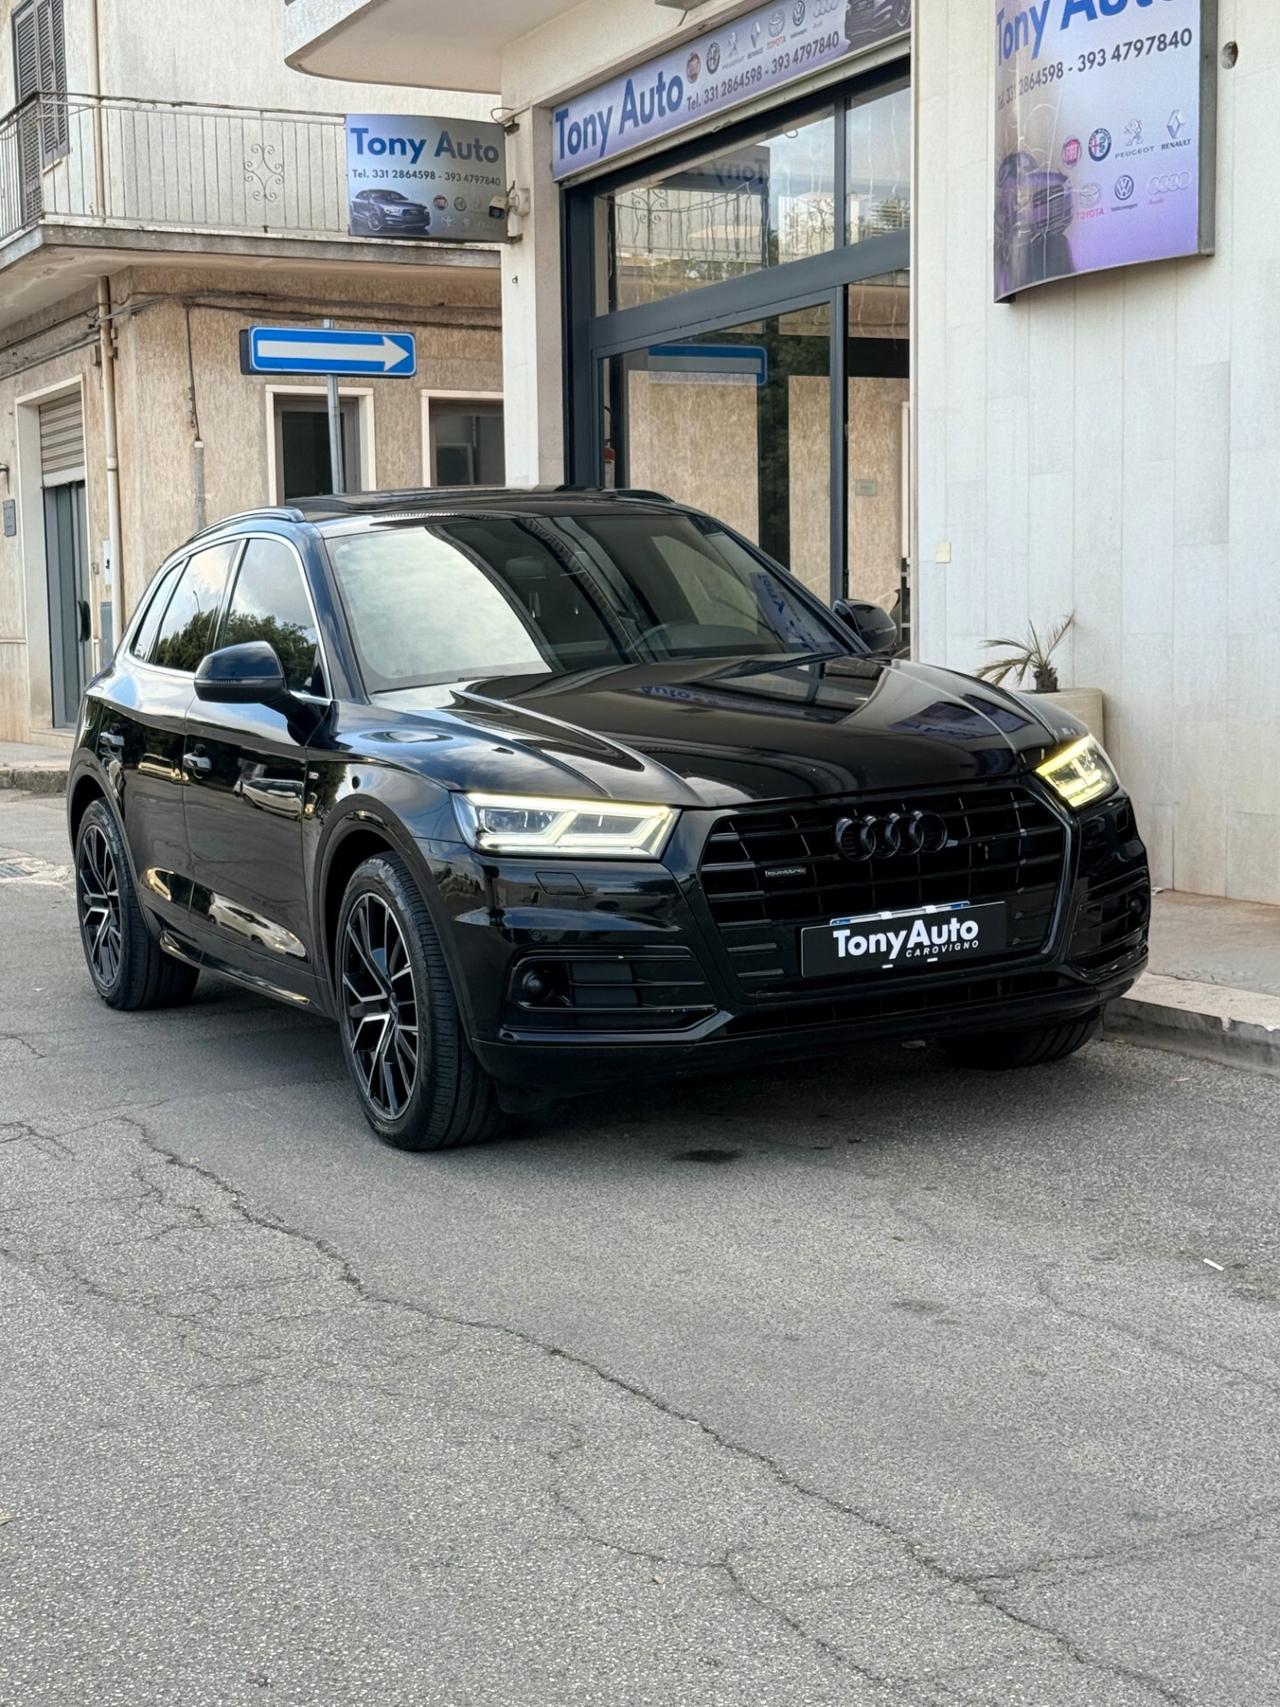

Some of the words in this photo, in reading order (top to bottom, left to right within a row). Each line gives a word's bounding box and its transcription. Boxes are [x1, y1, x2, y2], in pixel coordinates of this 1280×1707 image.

[996, 0, 1050, 66] Tony
[1060, 0, 1172, 30] Au
[687, 95, 701, 112] Tel.
[704, 87, 719, 104] 331
[721, 65, 762, 97] 2864598
[771, 52, 790, 75] 393
[792, 31, 839, 64] 4797840
[1018, 61, 1064, 96] 2864598
[1078, 48, 1106, 73] 393
[1110, 28, 1192, 62] 4797840
[555, 108, 613, 160] Tony
[619, 71, 683, 135] Auto
[350, 128, 427, 164] Tony
[434, 131, 499, 163] Auto
[1114, 145, 1155, 159] PEUGEOT
[1161, 138, 1192, 150] RENAULT
[353, 170, 369, 179] Tel.
[372, 170, 389, 179] 331
[392, 170, 436, 180] 2864598
[445, 172, 461, 182] 393
[464, 175, 500, 186] 4797840
[1076, 208, 1104, 221] TOYOTA
[906, 940, 979, 958] CAROVIGNO
